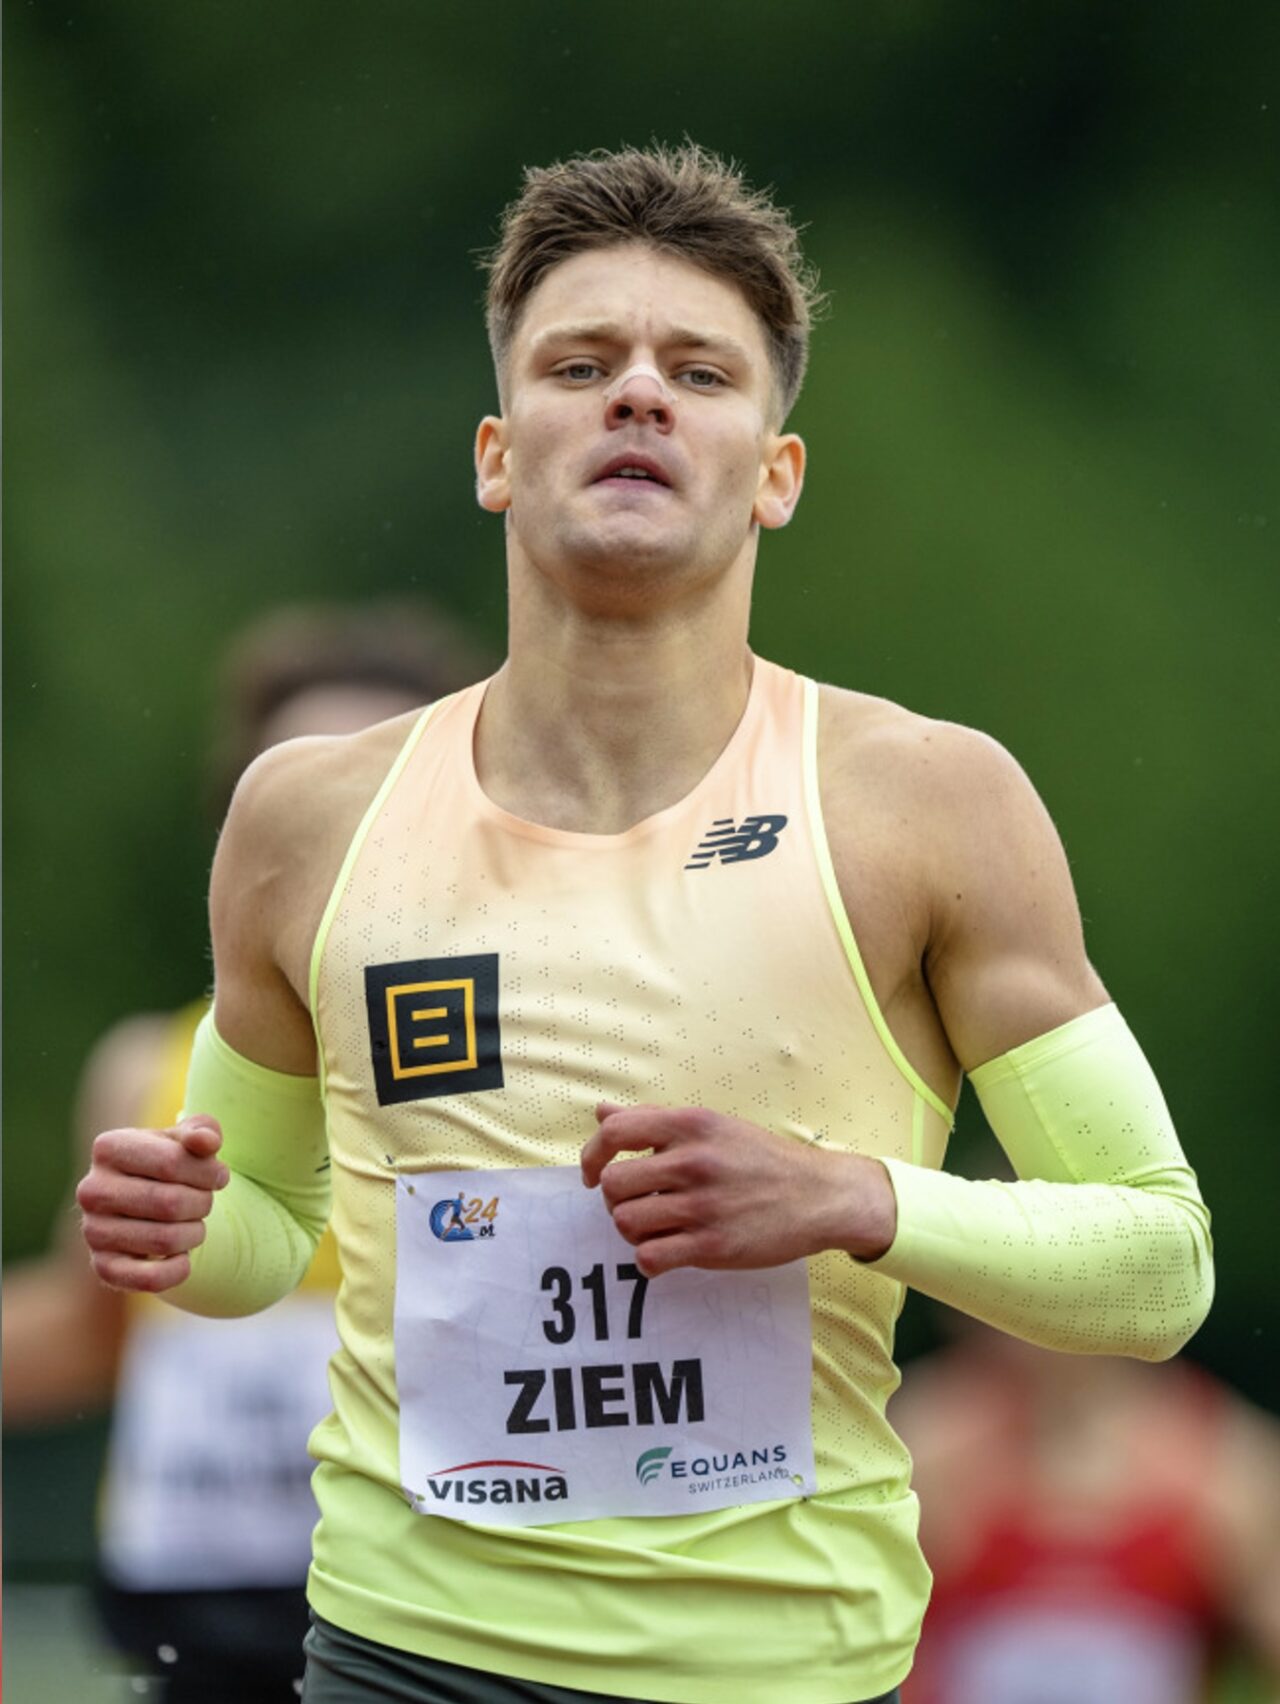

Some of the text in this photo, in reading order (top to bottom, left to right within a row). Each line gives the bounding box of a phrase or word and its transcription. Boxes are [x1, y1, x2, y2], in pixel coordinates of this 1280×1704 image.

[540, 1263, 649, 1345] 317
[503, 1358, 705, 1434] ZIEM
[671, 1445, 787, 1479] EQUANS
[688, 1466, 789, 1494] SWITZERLAND
